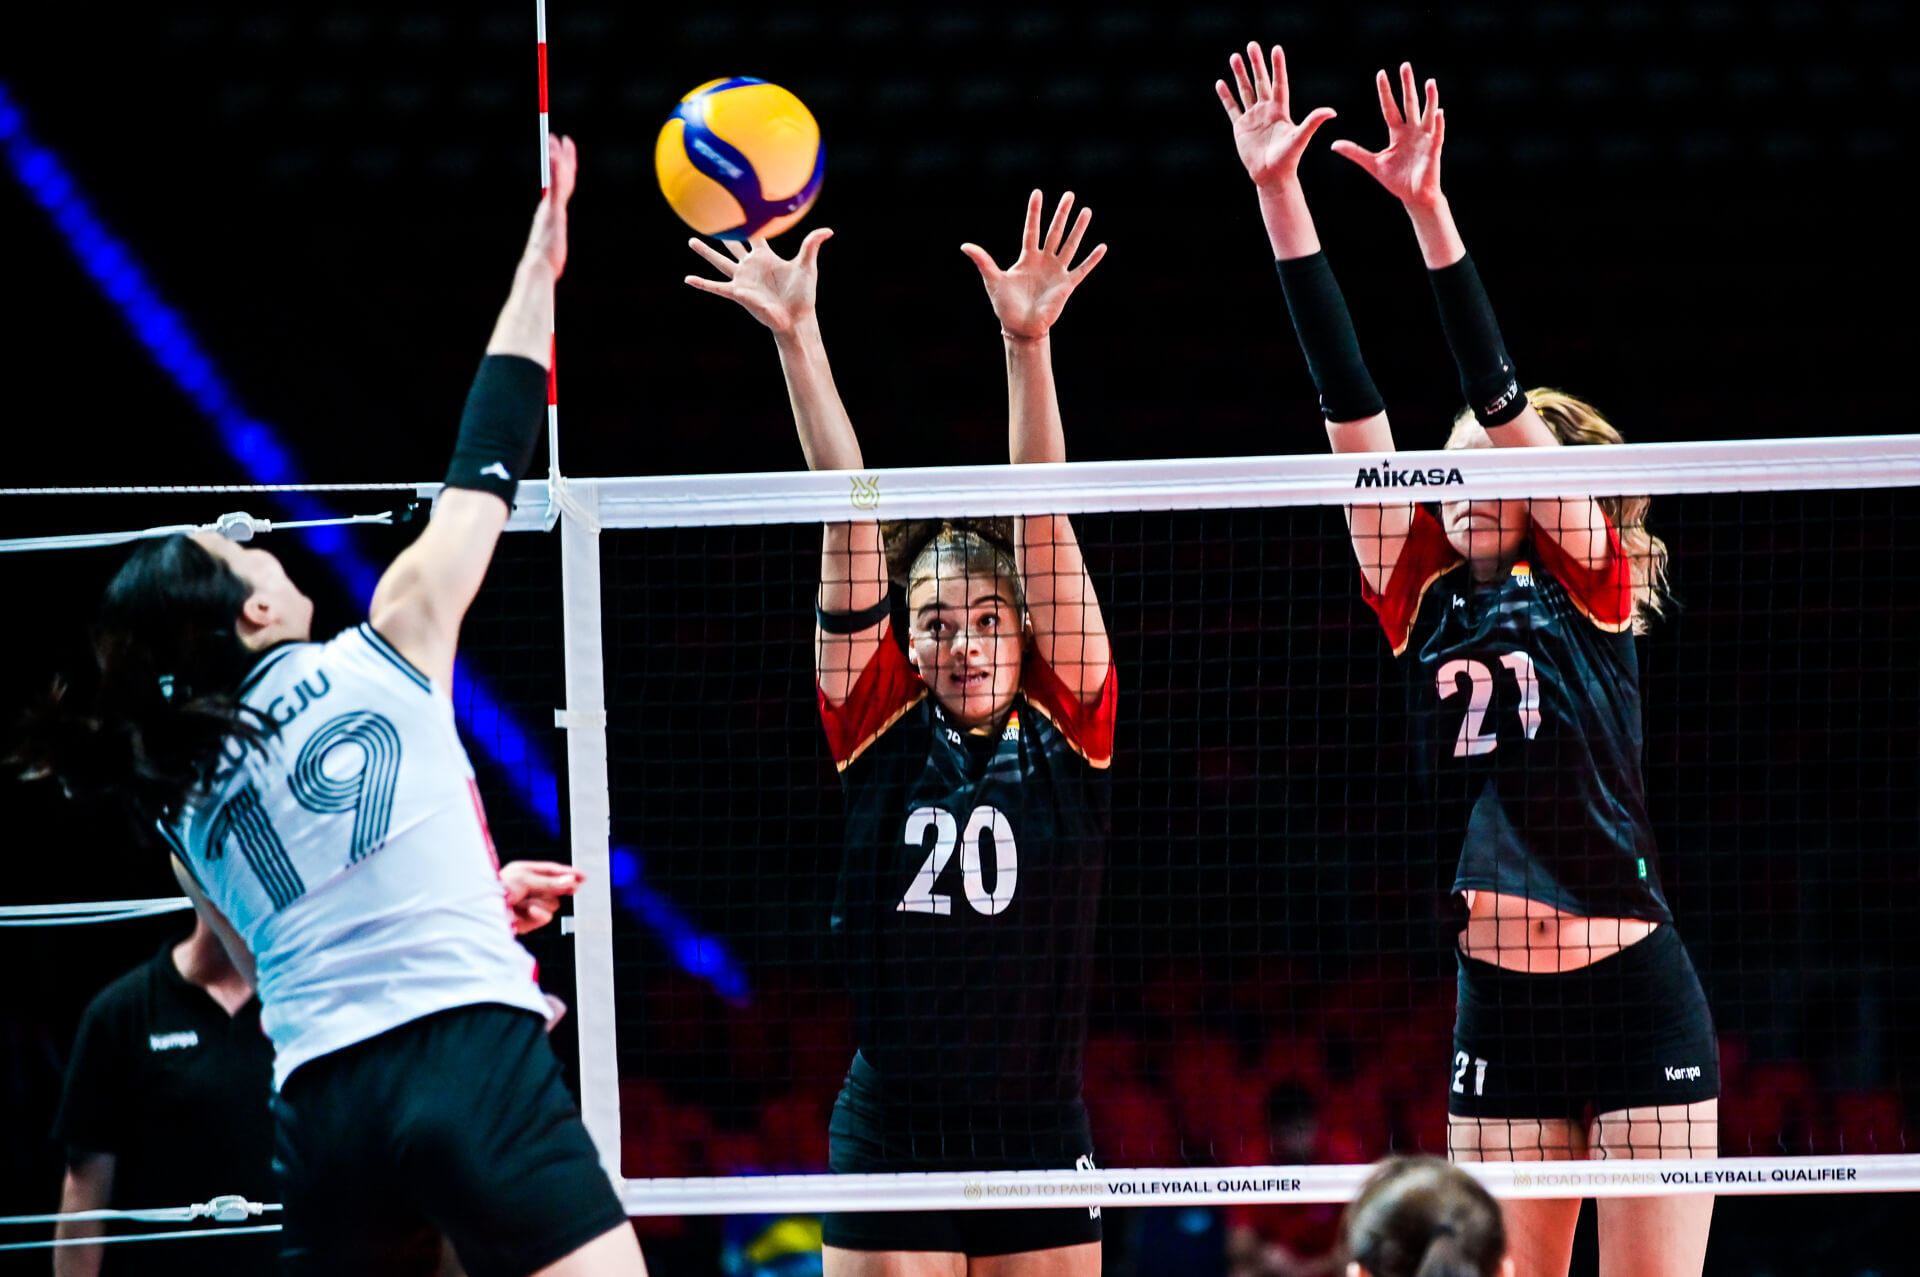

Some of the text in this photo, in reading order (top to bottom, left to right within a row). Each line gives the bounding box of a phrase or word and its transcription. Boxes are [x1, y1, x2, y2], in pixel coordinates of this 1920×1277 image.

[1436, 650, 1542, 757] 21
[205, 709, 402, 912] 19
[896, 805, 1018, 915] 20
[1452, 1050, 1489, 1097] 21
[987, 1178, 1301, 1198] ROAD TO PARIS VOLLEYBALL QUALIFIER
[1537, 1168, 1857, 1186] ROAD TO PARIS VOLLEYBALL QUALIFIER
